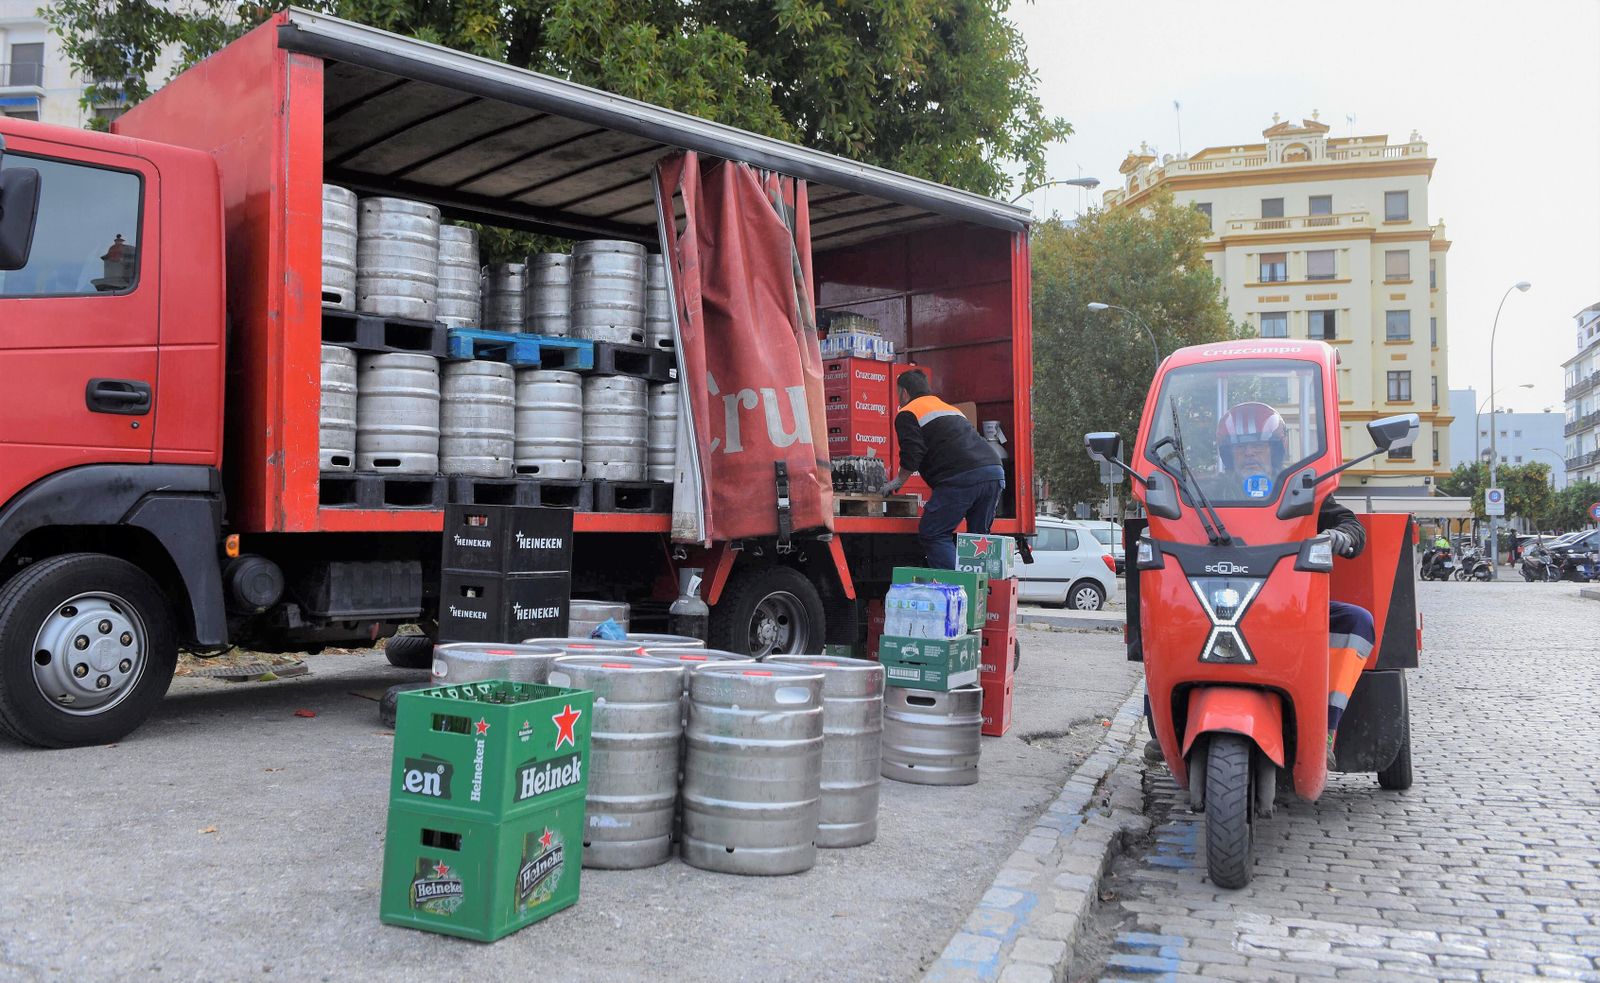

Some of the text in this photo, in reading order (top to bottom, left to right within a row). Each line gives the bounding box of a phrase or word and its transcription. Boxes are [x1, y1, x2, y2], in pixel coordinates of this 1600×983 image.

[1202, 347, 1301, 357] Cruzcampo
[855, 369, 886, 382] Cruzcampo
[855, 401, 886, 413] Cruzcampo
[855, 433, 887, 444] Cruzcampo
[457, 538, 492, 548] HEINEKEN
[519, 537, 563, 549] HEINEKEN
[1205, 561, 1249, 574] SCOBIC
[452, 609, 488, 620] HEINEKEN
[516, 606, 560, 620] HEINEKEN
[470, 739, 485, 802] Heineken
[403, 767, 442, 796] en
[520, 755, 582, 800] Heinek
